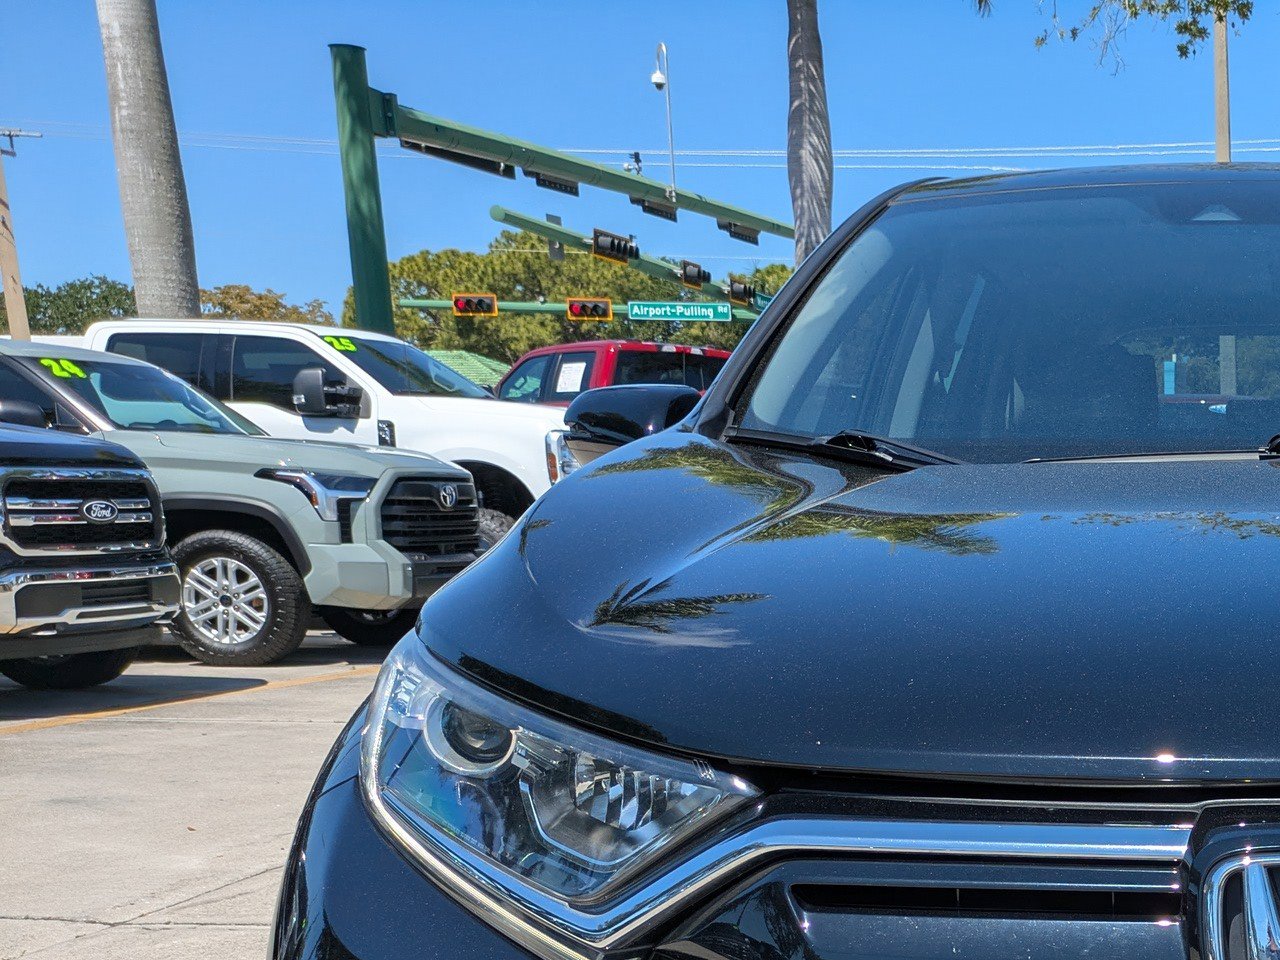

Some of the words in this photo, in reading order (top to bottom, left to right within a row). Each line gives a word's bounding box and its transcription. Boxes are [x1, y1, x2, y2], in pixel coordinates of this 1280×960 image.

[631, 304, 714, 319] Airport-Pulling
[717, 305, 728, 314] Rd
[323, 335, 358, 352] 25
[40, 358, 88, 378] 24
[91, 503, 112, 518] Ford
